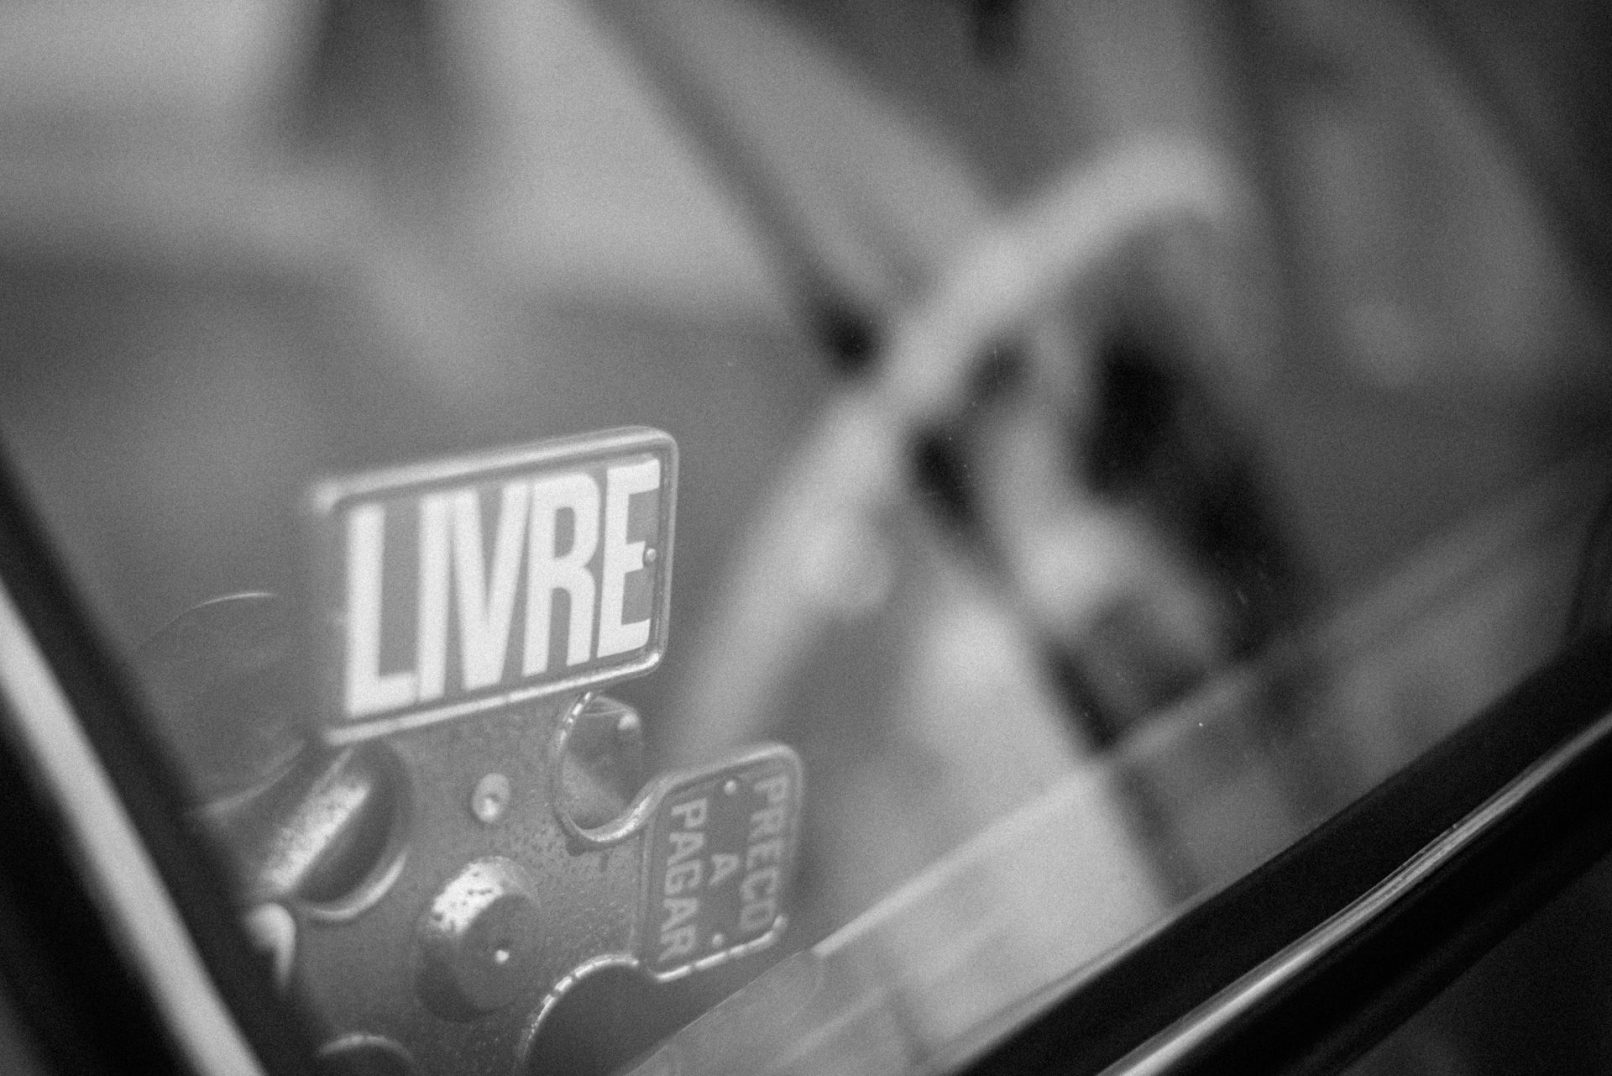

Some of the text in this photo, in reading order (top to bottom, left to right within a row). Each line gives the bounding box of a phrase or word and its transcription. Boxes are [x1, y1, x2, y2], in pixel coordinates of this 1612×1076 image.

[346, 457, 660, 718] LIVRE
[658, 797, 707, 962] PAGAR
[709, 853, 739, 886] A
